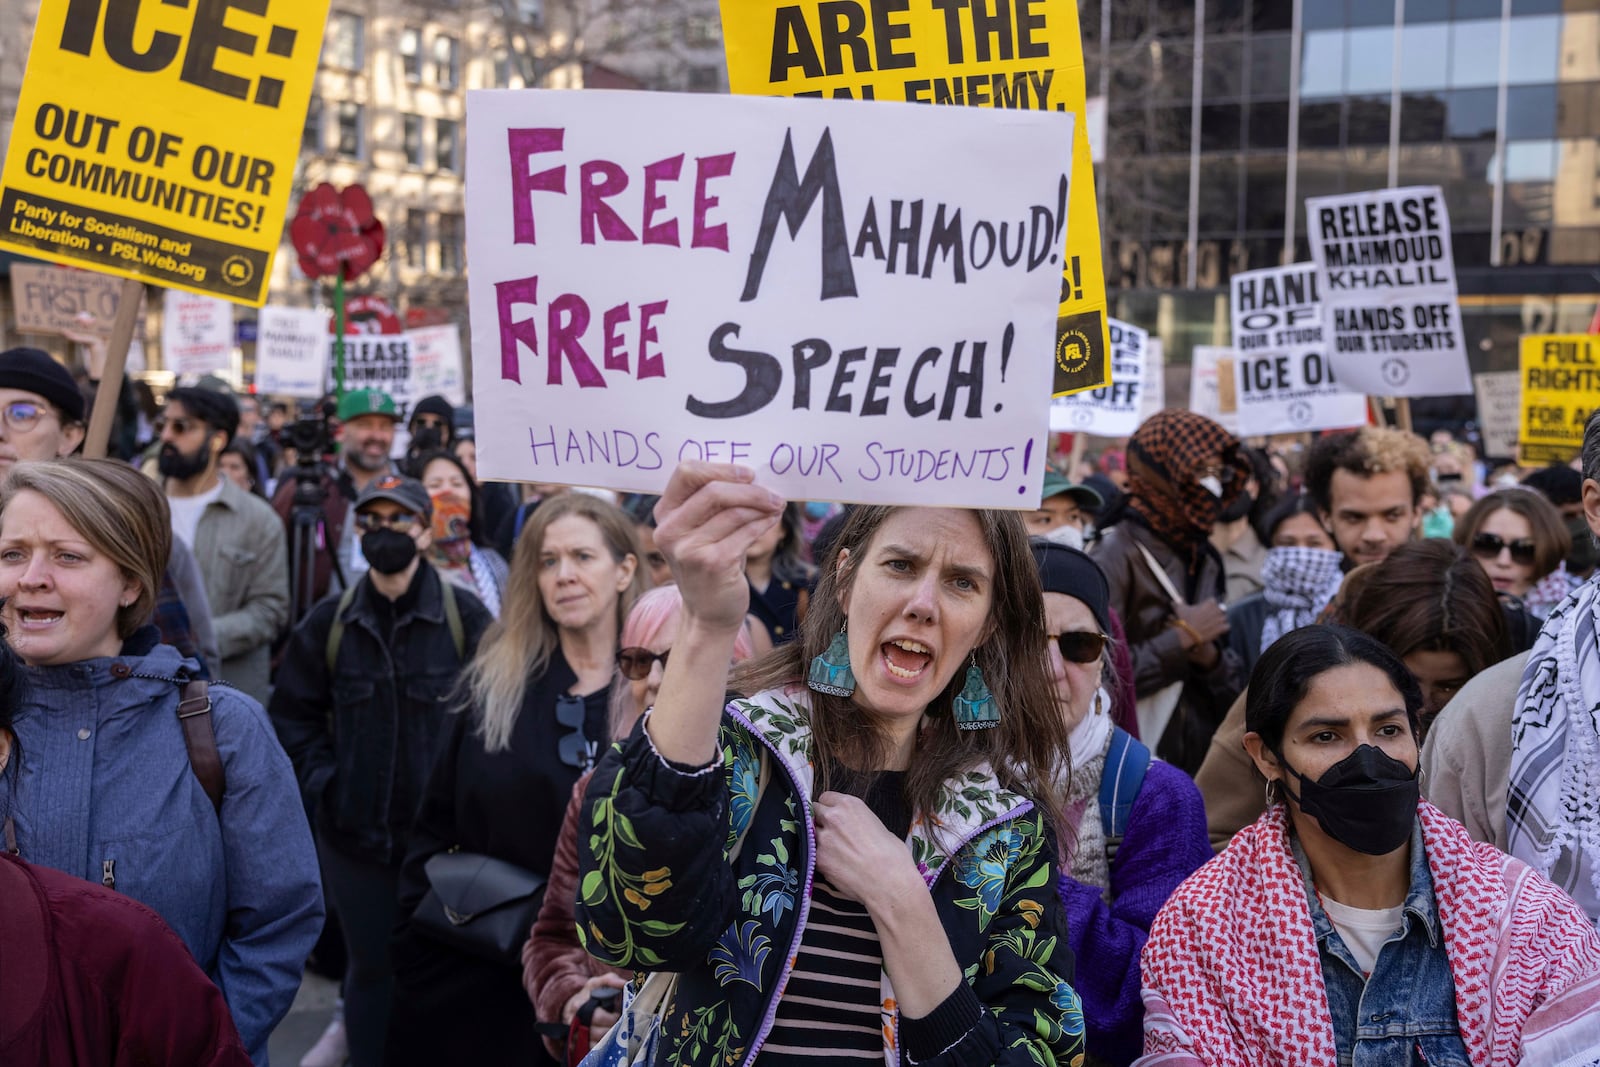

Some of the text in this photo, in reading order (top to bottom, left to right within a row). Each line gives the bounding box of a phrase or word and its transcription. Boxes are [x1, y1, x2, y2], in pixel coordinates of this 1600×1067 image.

[769, 0, 1050, 83] ARE THE
[34, 103, 276, 197] OUT OF OUR
[25, 148, 266, 233] COMMUNITIES!
[14, 199, 192, 256] Party for Socialism and
[507, 126, 1068, 301] FREE MAHMOUD!
[1320, 196, 1439, 239] RELEASE
[10, 218, 90, 250] Liberation
[110, 241, 207, 282] PSLWeb.org
[1323, 235, 1443, 266] MAHMOUD
[1328, 265, 1448, 289] KHALIL
[1335, 304, 1450, 331] HANDS OFF
[493, 275, 1016, 421] FREE SPEECH!
[1064, 343, 1083, 361] PSL
[1336, 332, 1456, 352] OUR STUDENTS
[1543, 342, 1596, 364] FULL
[1242, 357, 1291, 392] ICE
[1528, 406, 1565, 427] FOR
[529, 426, 664, 470] HANDS
[770, 443, 843, 483] OUR
[859, 437, 1035, 495] STUDENTS!
